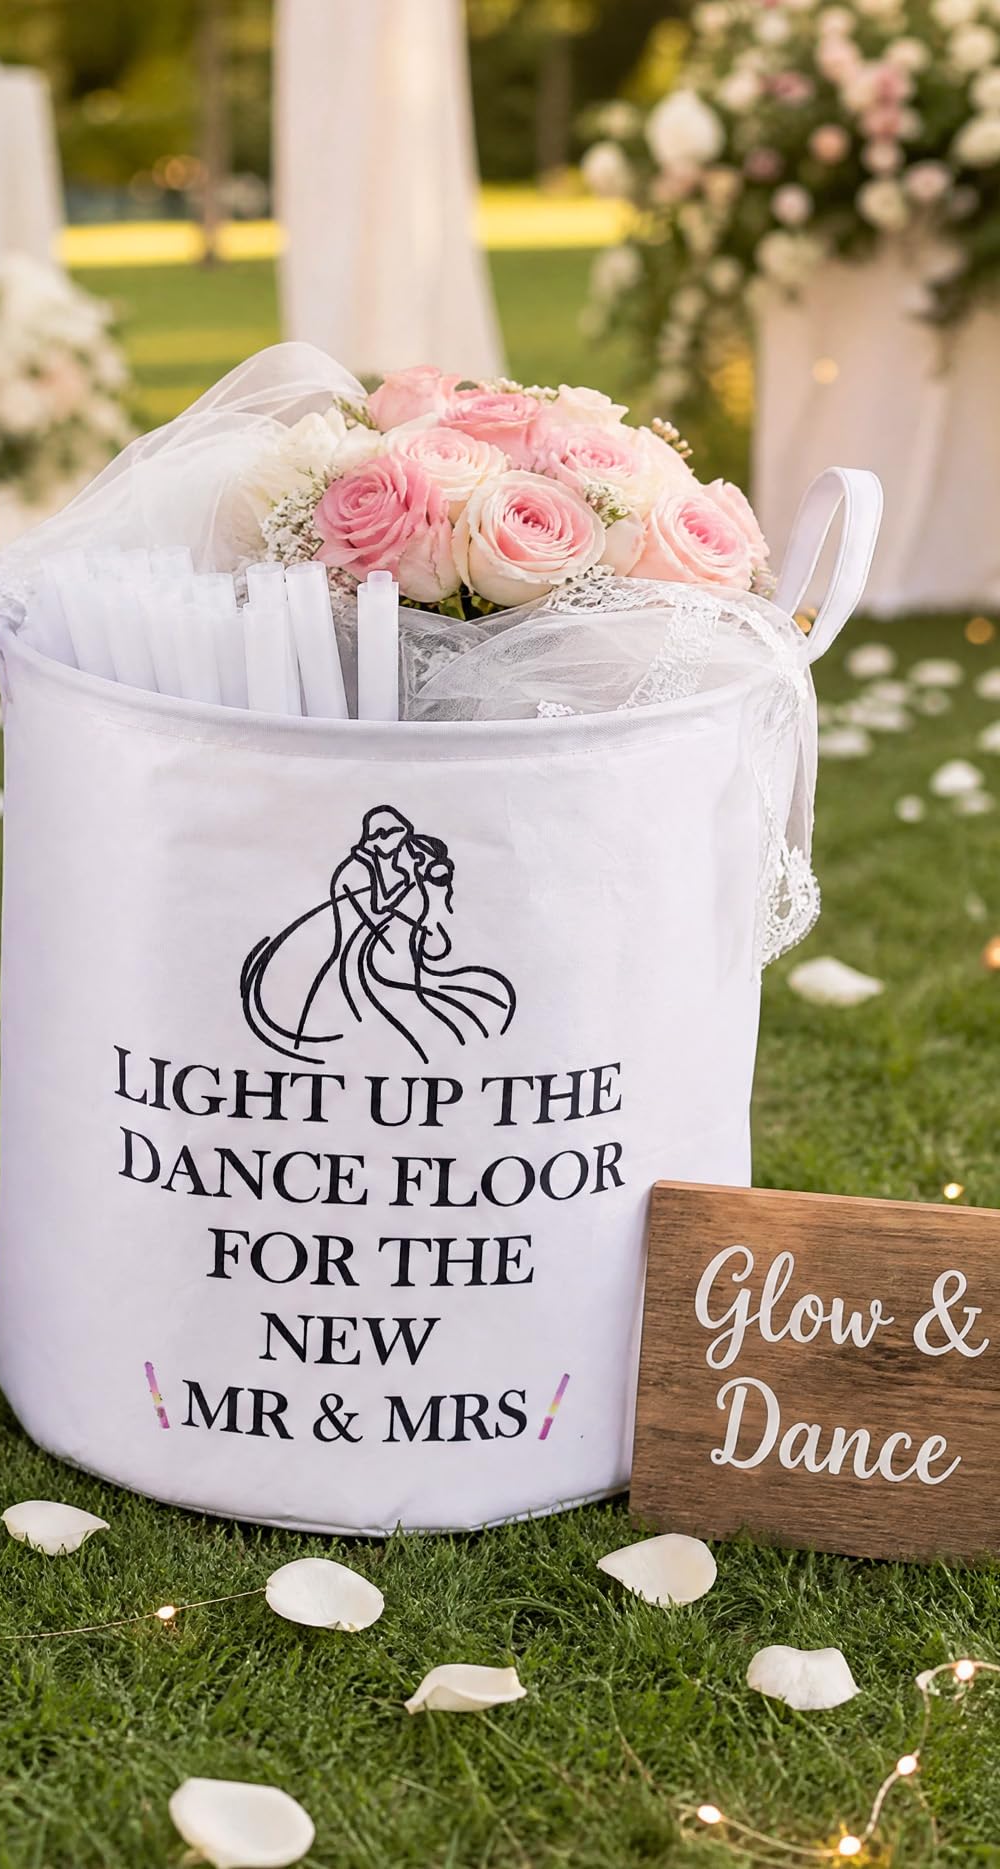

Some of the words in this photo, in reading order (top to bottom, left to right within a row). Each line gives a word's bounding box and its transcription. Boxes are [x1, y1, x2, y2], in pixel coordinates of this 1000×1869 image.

[114, 1046, 345, 1122] LIGHT
[365, 1076, 463, 1126] UP
[482, 1063, 621, 1126] THE
[119, 1127, 367, 1205] DANCE
[389, 1143, 625, 1207] FLOOR
[207, 1228, 359, 1286] FOR
[379, 1235, 534, 1286] THE
[259, 1312, 441, 1365] NEW
[694, 1244, 895, 1370] Glow
[913, 1269, 990, 1358] &
[181, 1380, 294, 1439] MR
[313, 1393, 363, 1442] &
[383, 1390, 528, 1442] MRS
[710, 1376, 962, 1485] Dance
